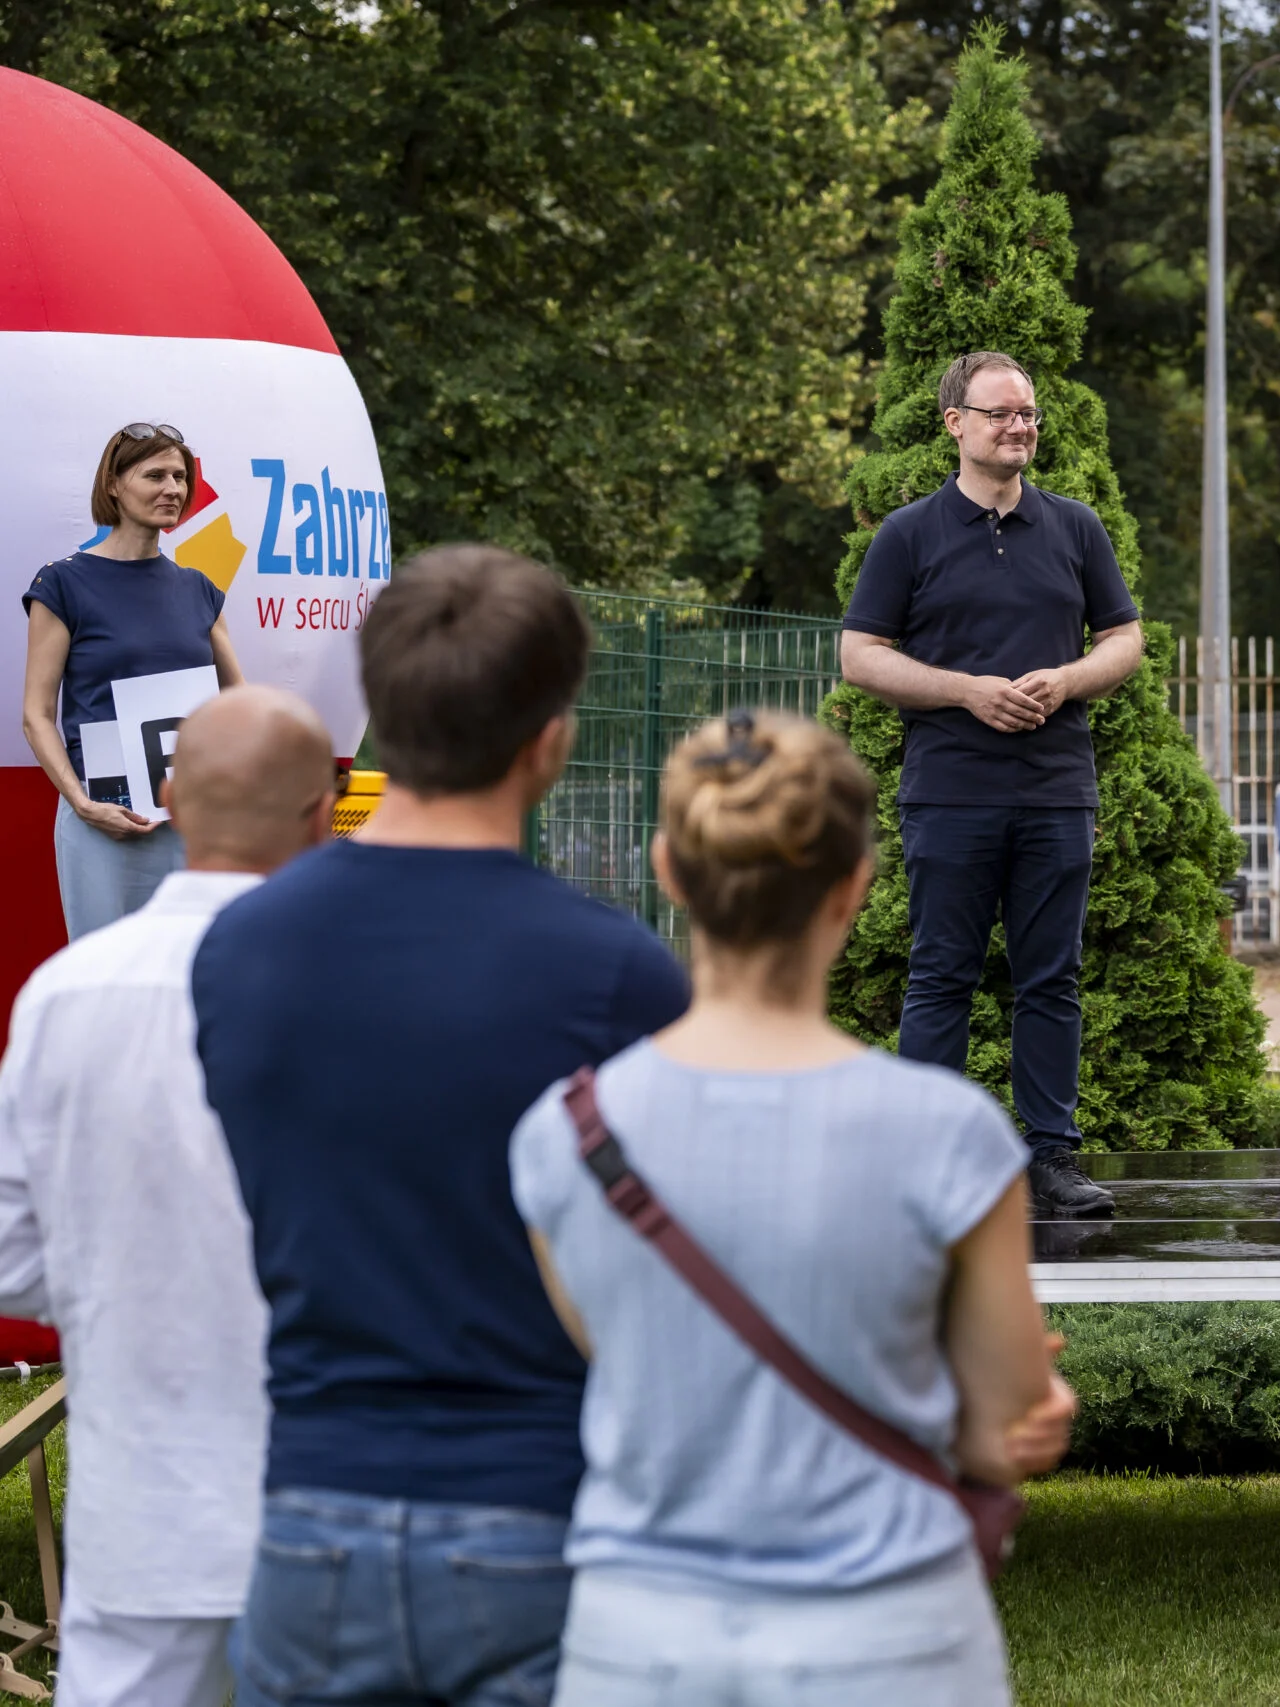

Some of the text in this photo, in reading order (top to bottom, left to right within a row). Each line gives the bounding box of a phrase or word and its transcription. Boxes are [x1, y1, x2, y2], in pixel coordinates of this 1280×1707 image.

[251, 459, 391, 580] Zabrze
[257, 582, 376, 631] w sercu Śl
